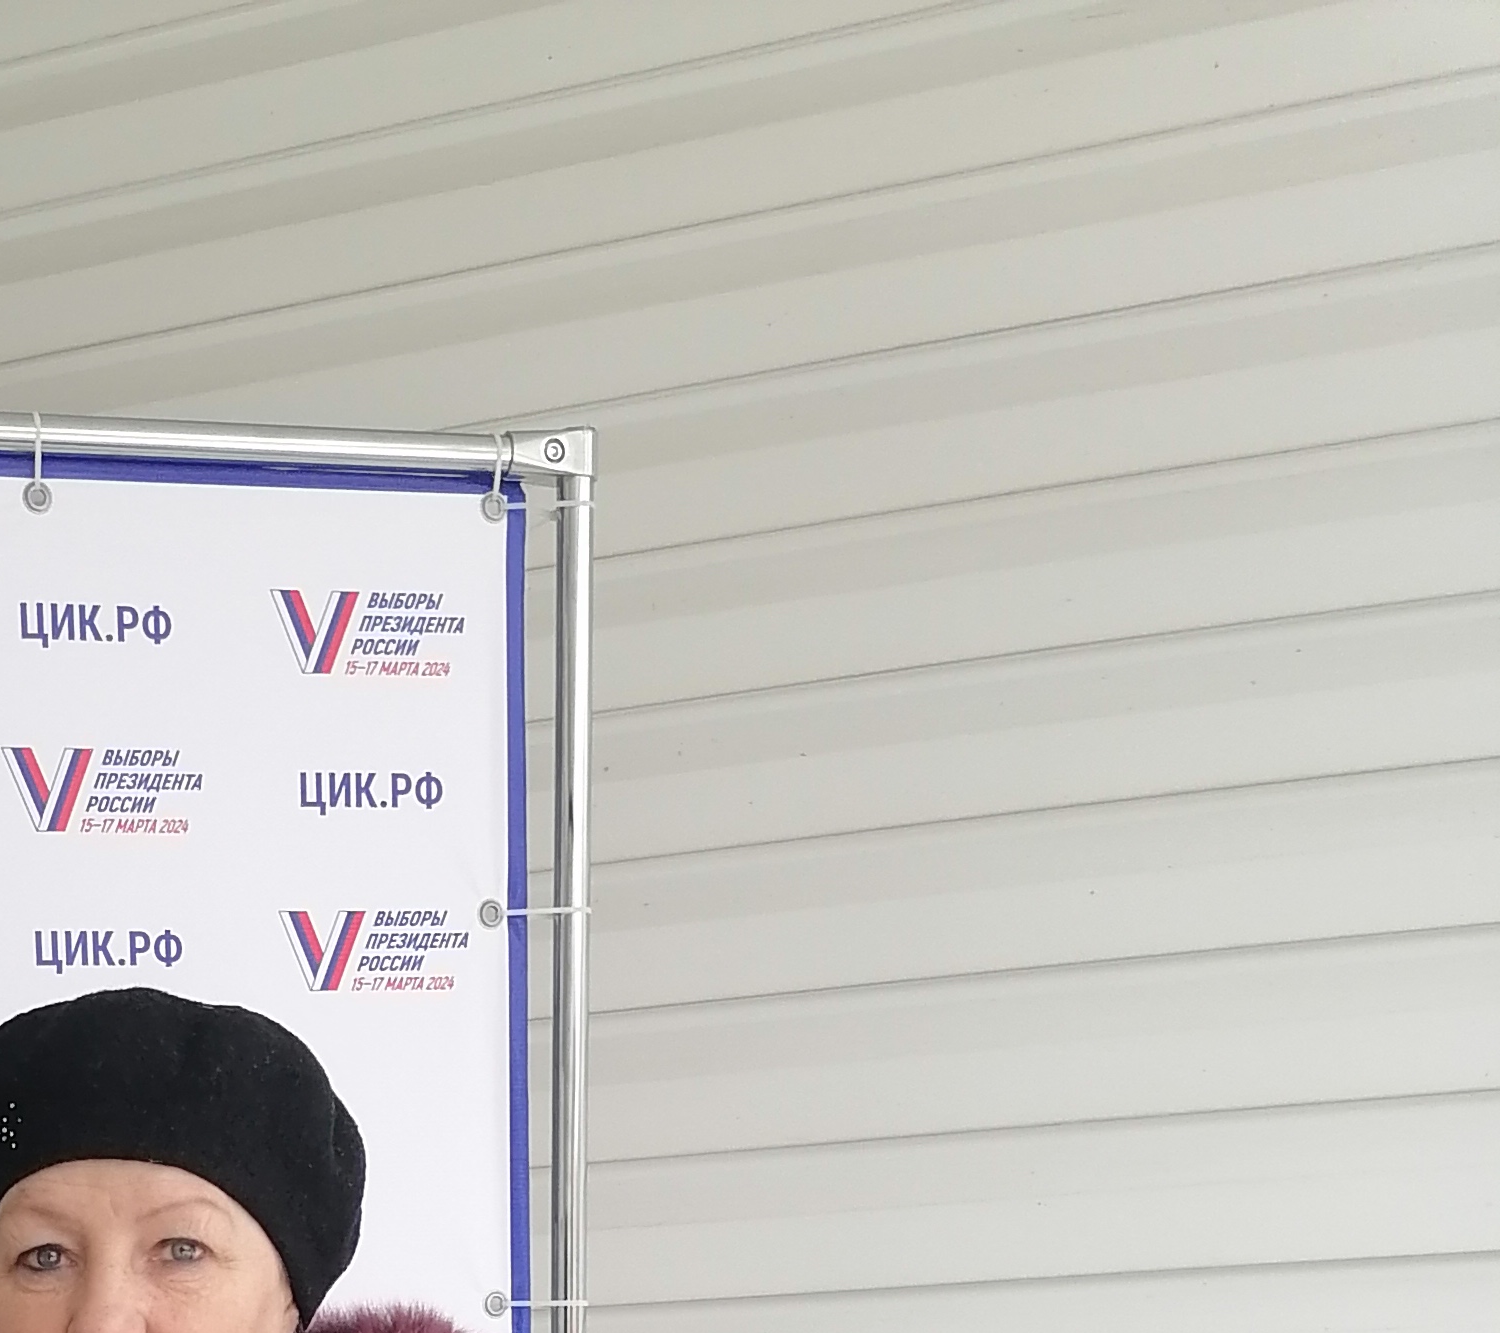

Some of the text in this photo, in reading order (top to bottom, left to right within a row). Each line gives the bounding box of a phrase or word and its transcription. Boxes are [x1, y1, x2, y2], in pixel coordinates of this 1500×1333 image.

[367, 592, 443, 610] ВЫБОРЫ
[20, 603, 171, 648] ЦИК.РФ
[359, 616, 464, 635] ПРЕЗИДЕНТА
[351, 639, 420, 656] РОССИИ
[379, 661, 419, 676] МАРТА
[422, 662, 450, 676] 2024
[102, 750, 180, 766] ВЫБОРЫ
[94, 773, 202, 792] ПРЕЗИДЕНТА
[300, 772, 442, 815] ЦИК.РФ
[86, 796, 157, 813] РОССИИ
[115, 819, 157, 833] МАРТА
[159, 819, 188, 833] 2024
[373, 911, 447, 926] ВЫБОРЫ
[365, 932, 469, 951] ПРЕЗИДЕНТА
[35, 930, 182, 974] ЦИК.РФ
[357, 955, 425, 971] РОССИИ
[385, 977, 424, 990] МАРТА
[426, 976, 454, 990] 2024
